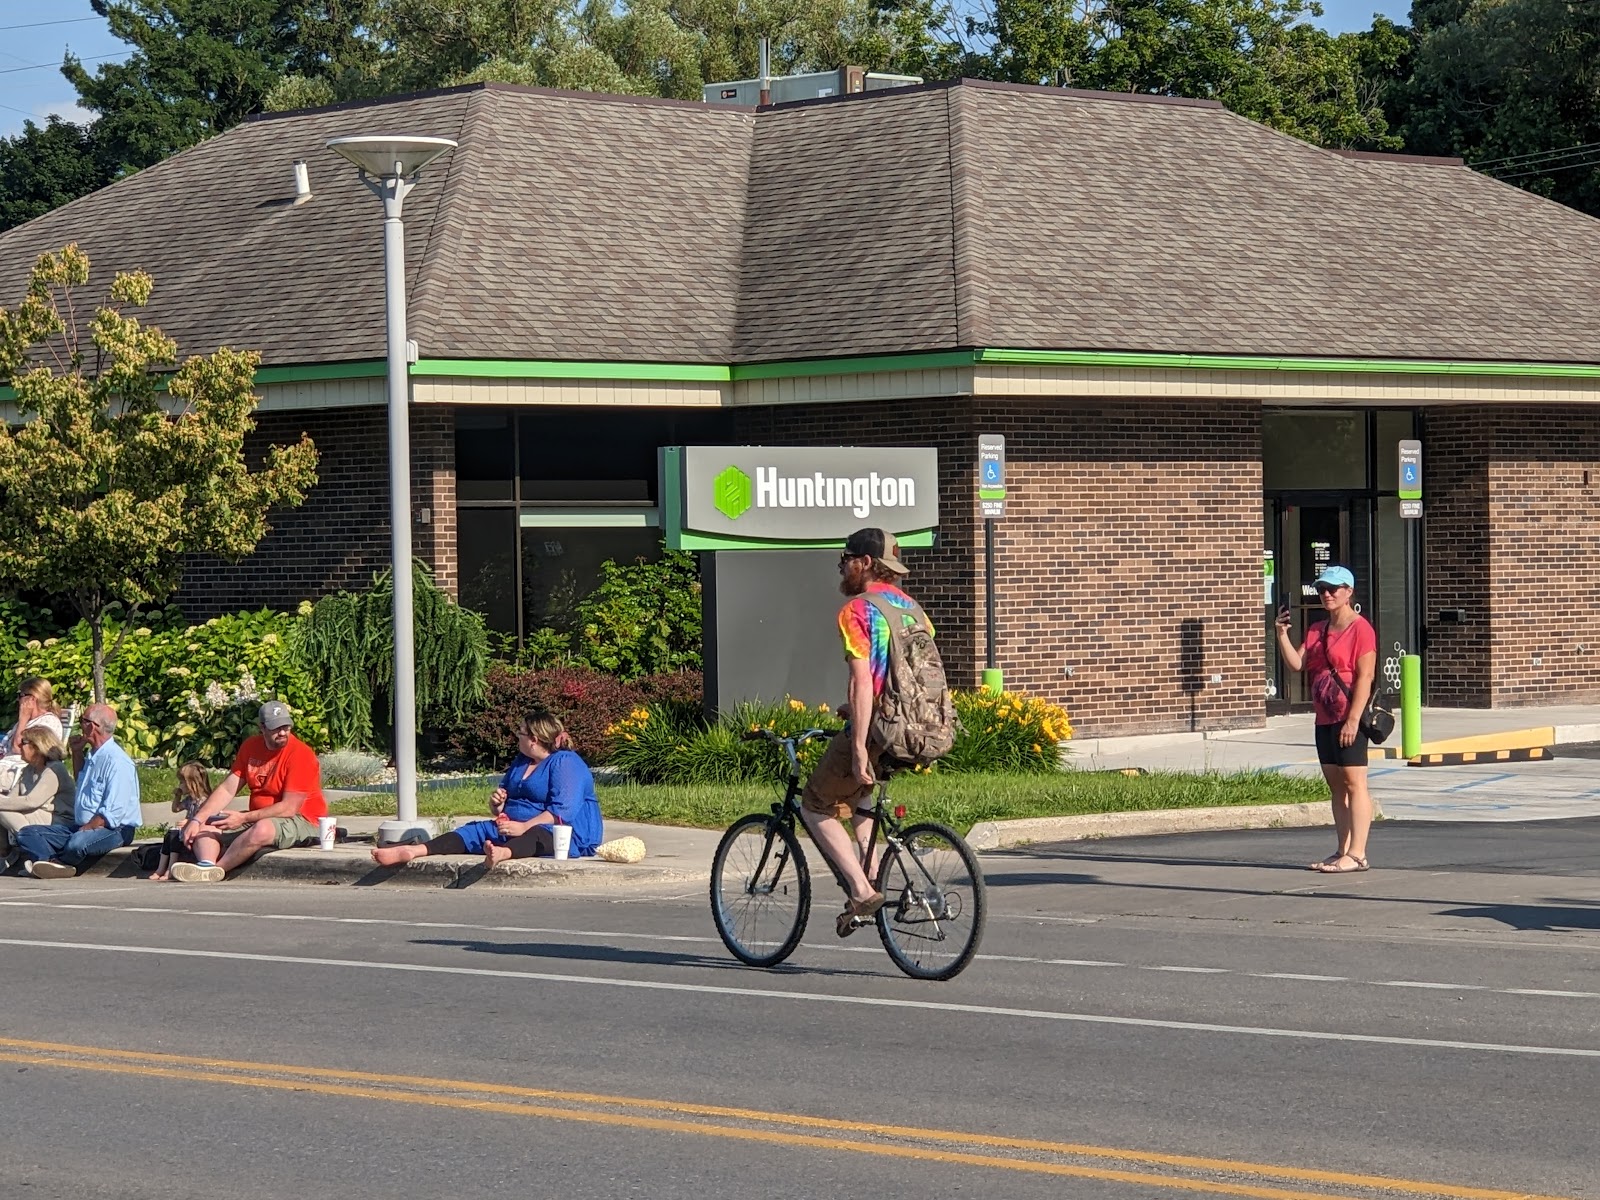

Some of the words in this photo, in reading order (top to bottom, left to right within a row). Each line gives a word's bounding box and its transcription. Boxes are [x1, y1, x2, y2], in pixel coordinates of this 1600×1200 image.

[980, 443, 1003, 451] Reserved
[1400, 447, 1420, 455] Reserved
[980, 452, 999, 461] Parking
[1400, 456, 1416, 464] Parking
[756, 466, 916, 519] Huntington
